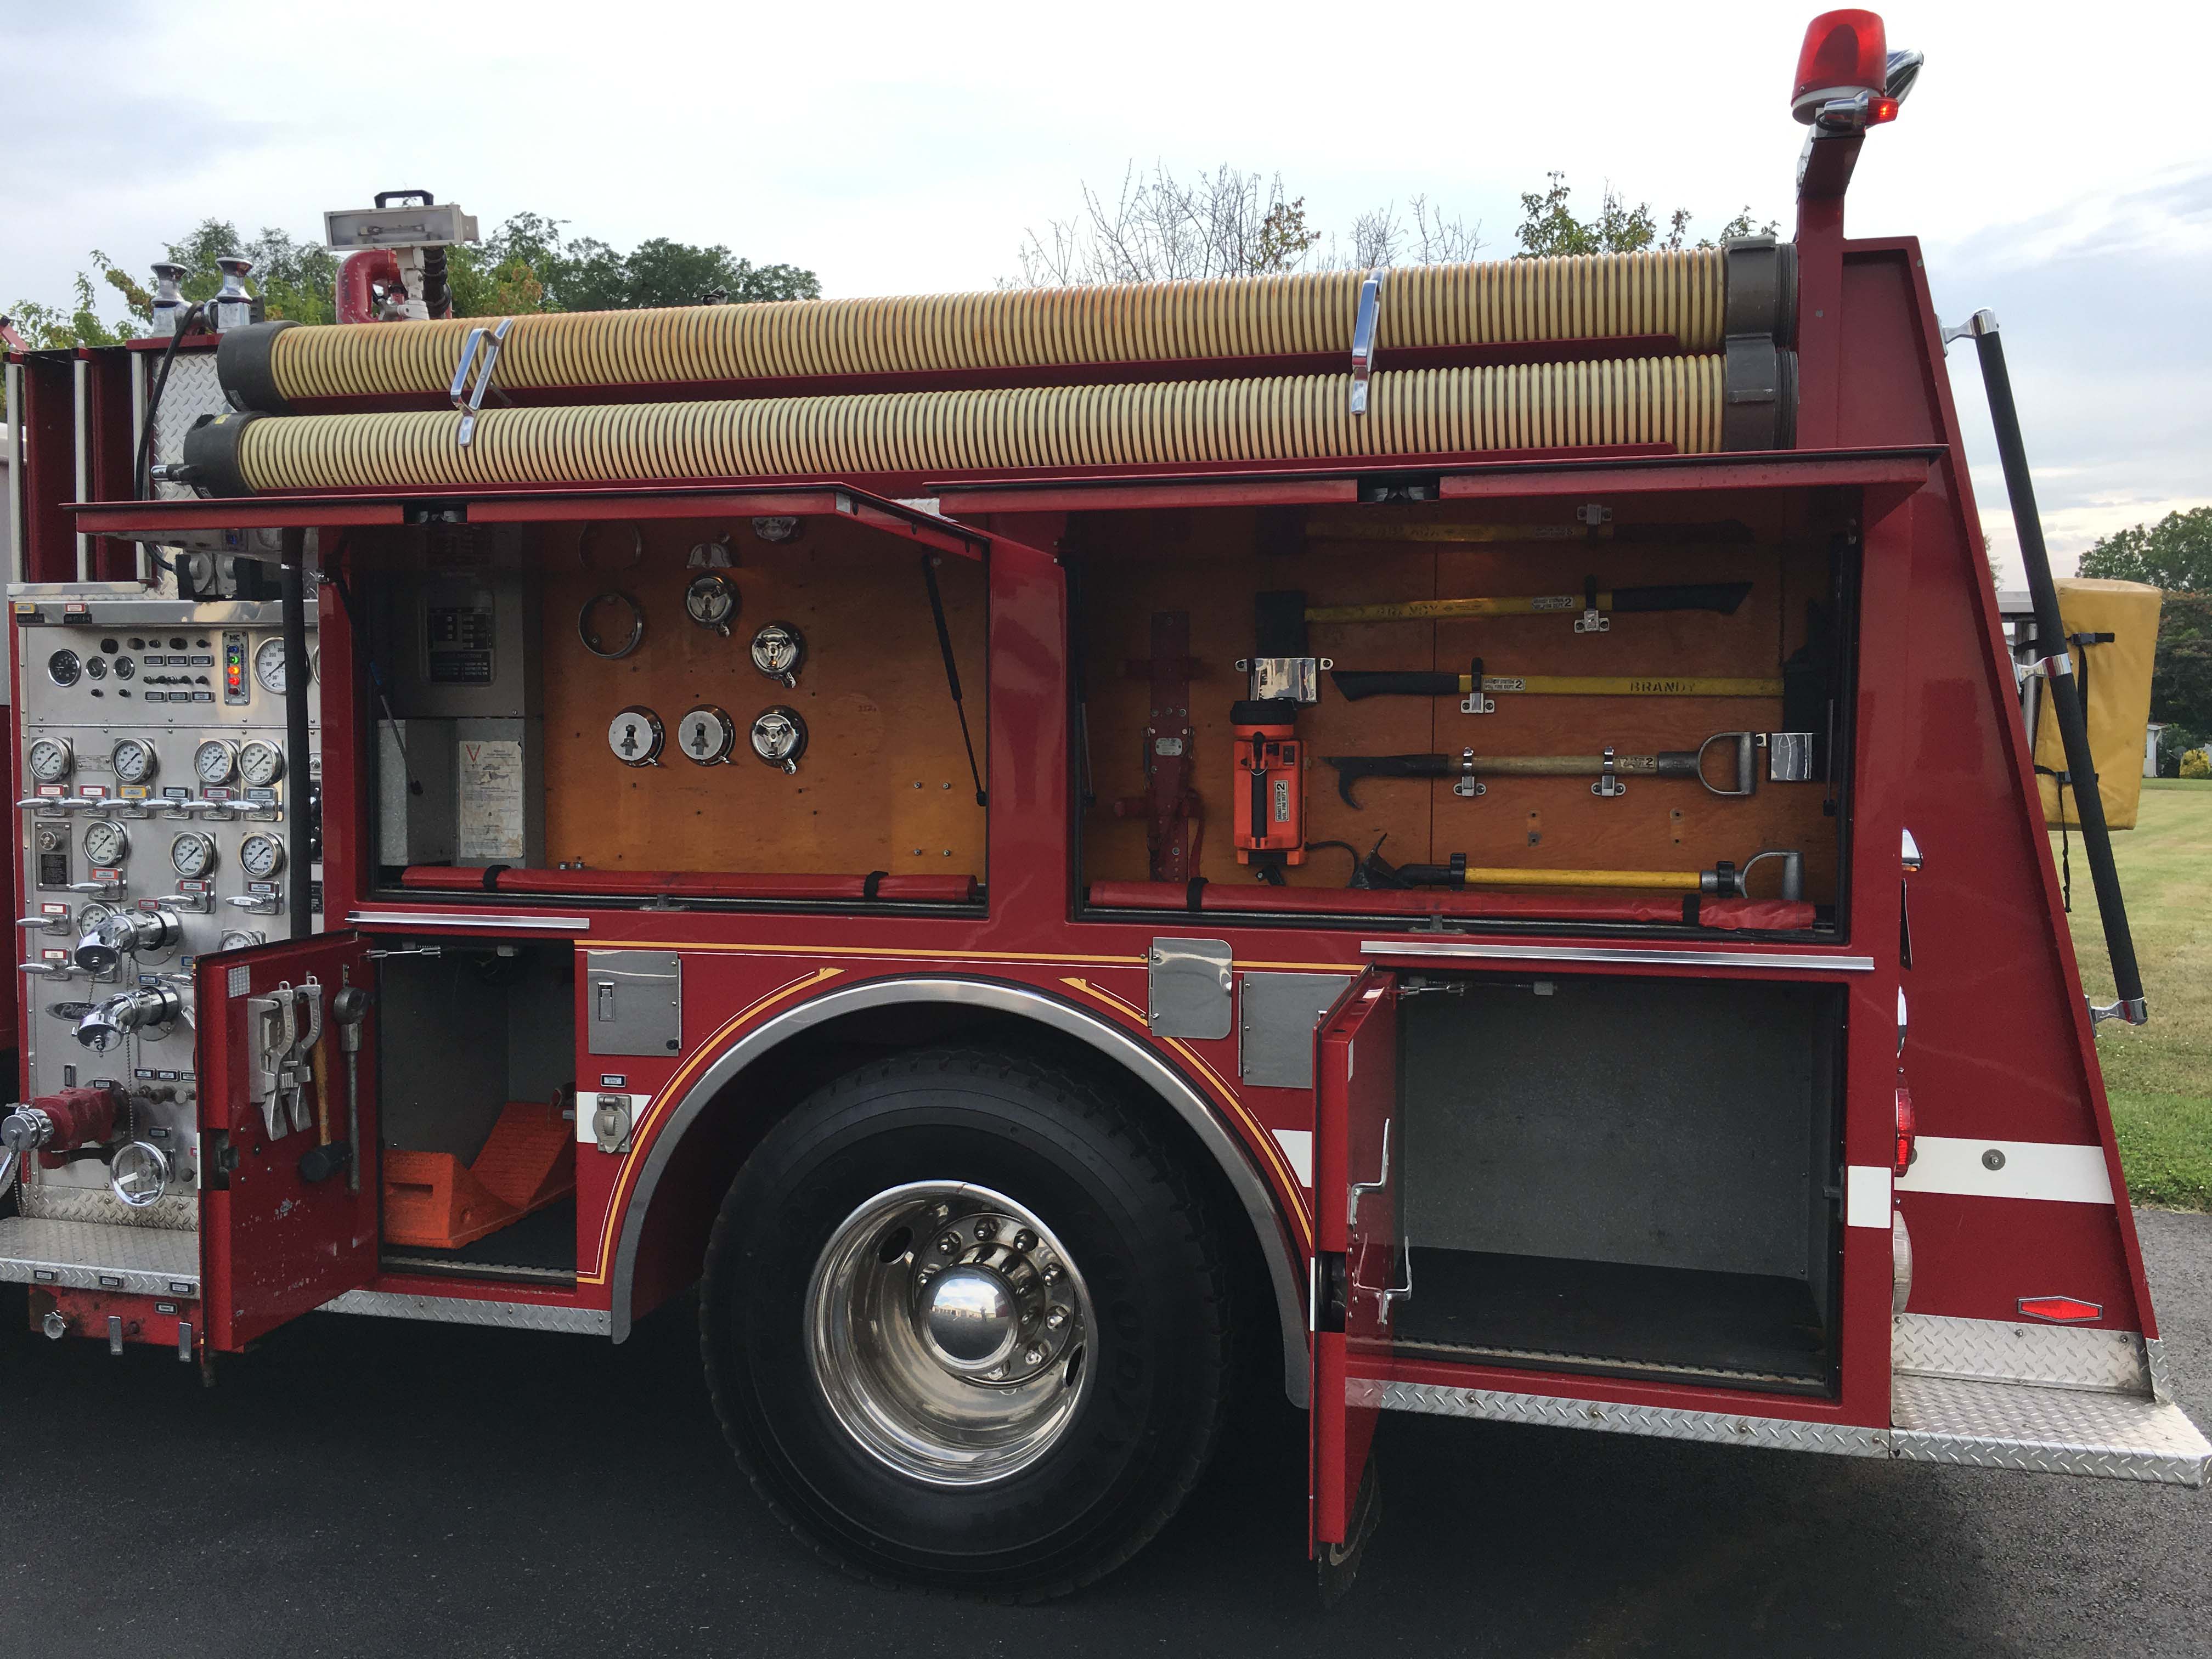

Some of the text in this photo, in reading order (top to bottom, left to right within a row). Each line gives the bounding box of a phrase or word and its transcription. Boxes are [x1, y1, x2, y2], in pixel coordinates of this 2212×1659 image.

[1515, 679, 1522, 690] 2
[1630, 682, 1695, 692] BRANDY
[1645, 758, 1654, 766] 2
